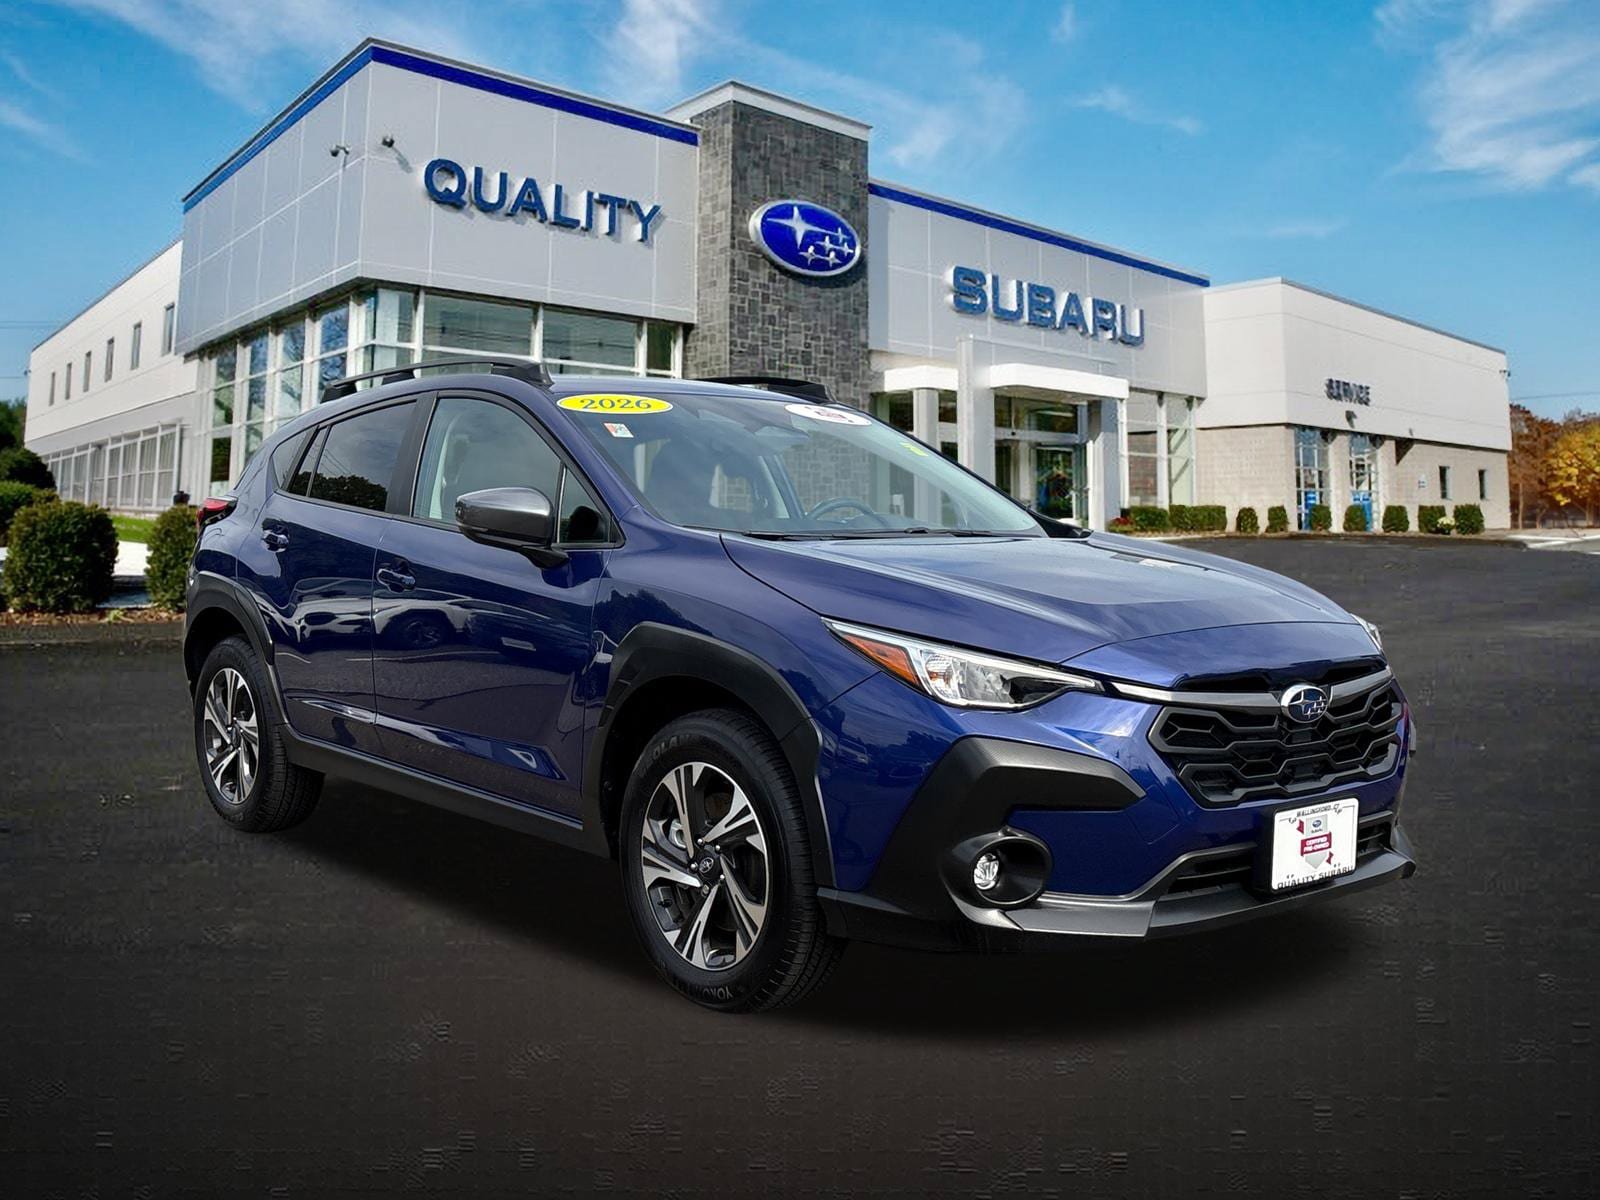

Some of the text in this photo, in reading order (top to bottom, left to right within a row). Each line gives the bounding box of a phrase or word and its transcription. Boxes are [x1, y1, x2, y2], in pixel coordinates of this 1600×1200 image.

[424, 158, 661, 243] QUALITY
[951, 265, 1145, 347] SUBARU
[579, 398, 652, 410] 2026
[1325, 378, 1371, 407] SERVICE
[1277, 865, 1354, 889] QUALITY SUBARU
